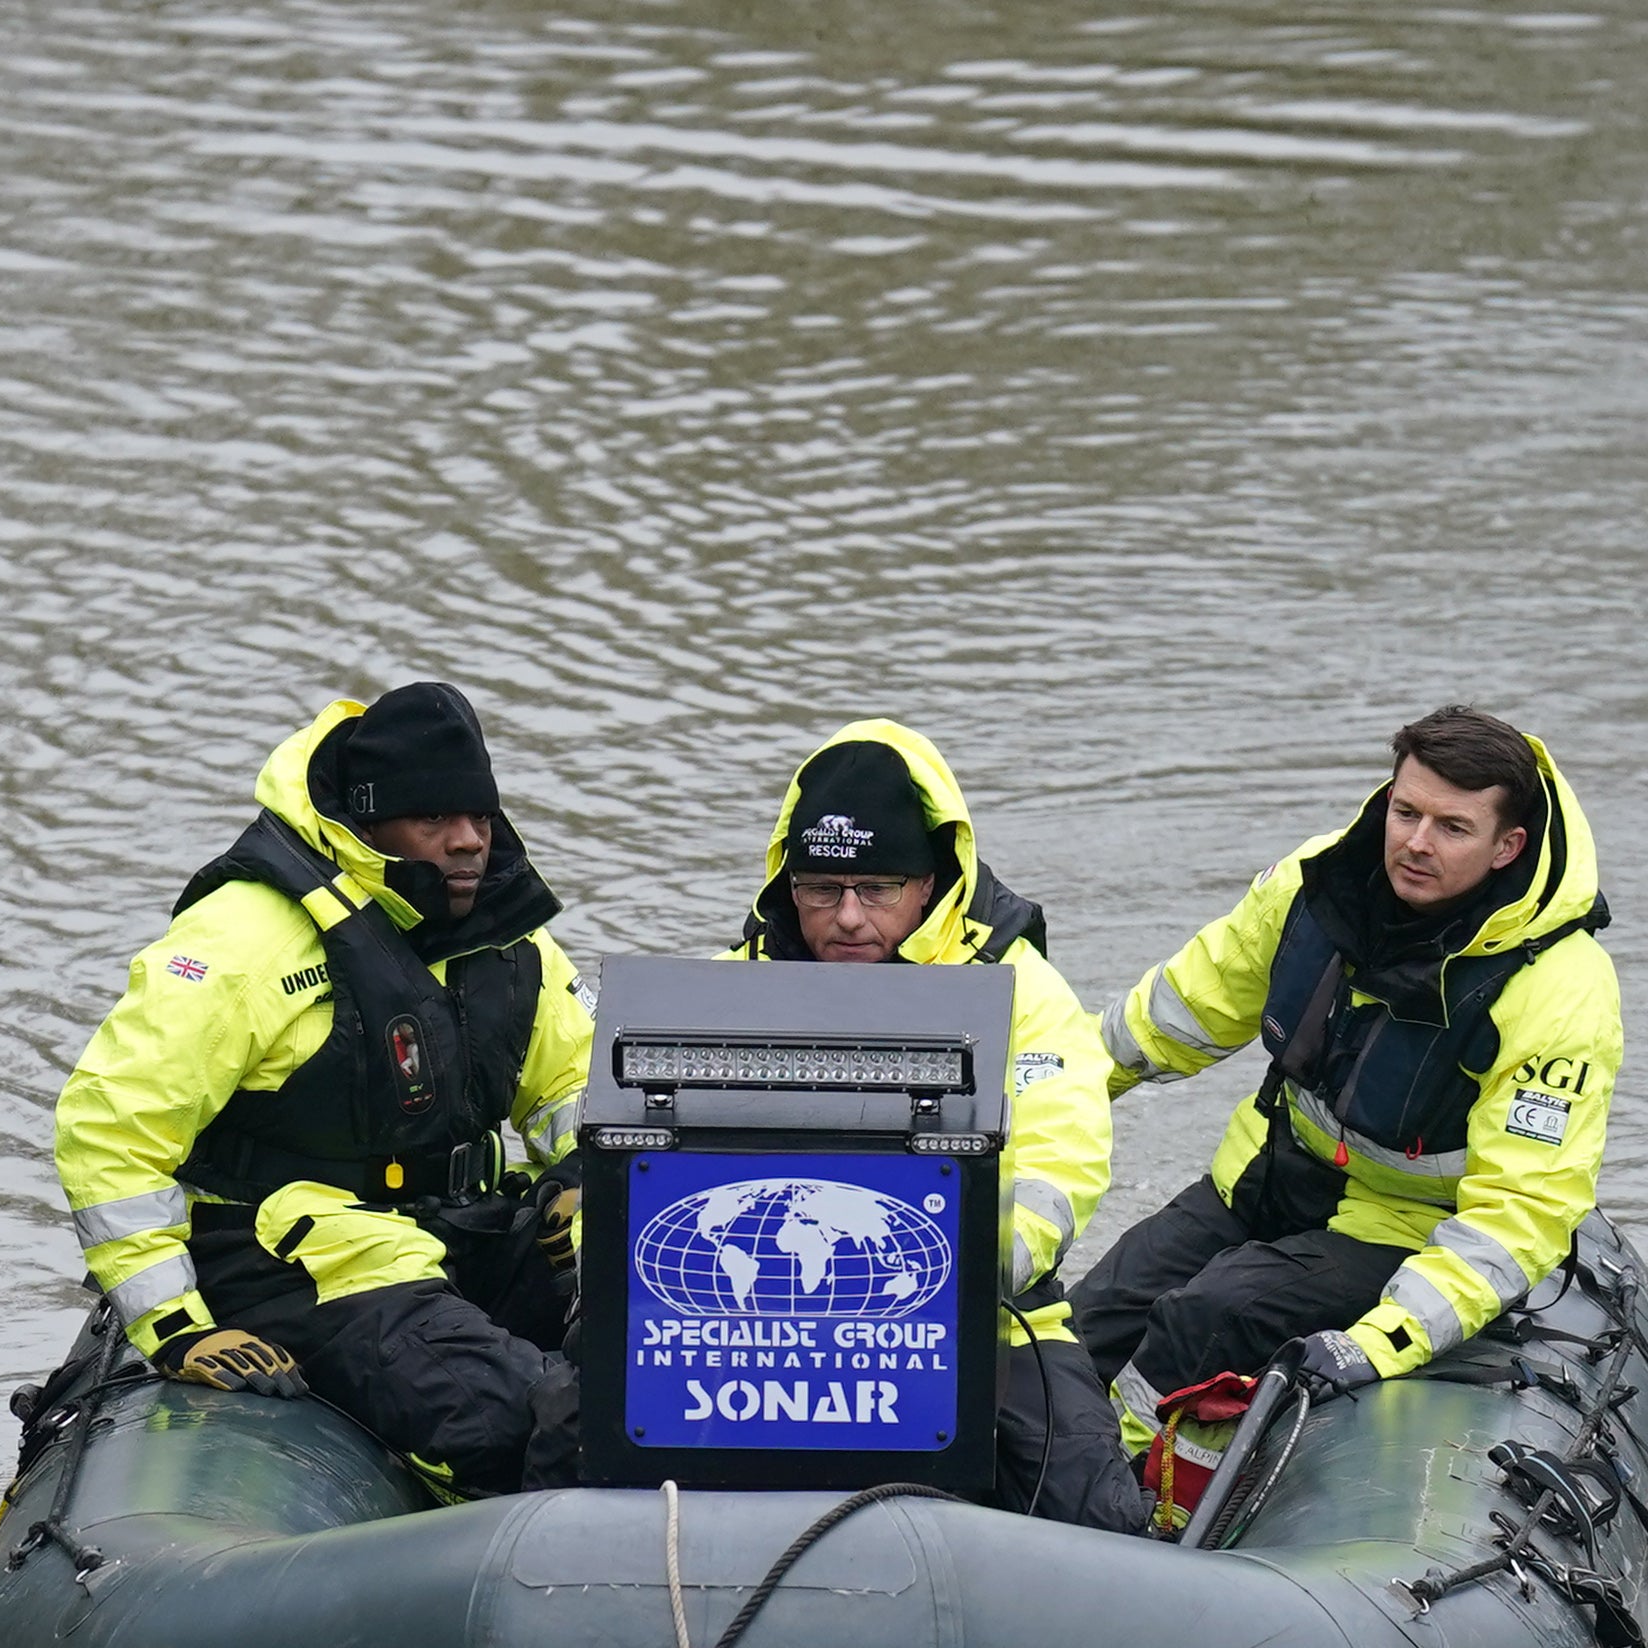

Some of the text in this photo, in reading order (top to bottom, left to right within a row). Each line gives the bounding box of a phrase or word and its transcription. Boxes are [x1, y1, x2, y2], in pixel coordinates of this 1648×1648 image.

[348, 782, 376, 814] GI
[808, 844, 857, 858] RESCUE
[1512, 1055, 1591, 1096] SGI
[1522, 1090, 1570, 1108] BALTIC
[1514, 1104, 1537, 1127] CE
[643, 1319, 947, 1349] SPECIALIST GROUP
[636, 1349, 948, 1371] INTERNATIONAL
[684, 1379, 900, 1424] SONAR
